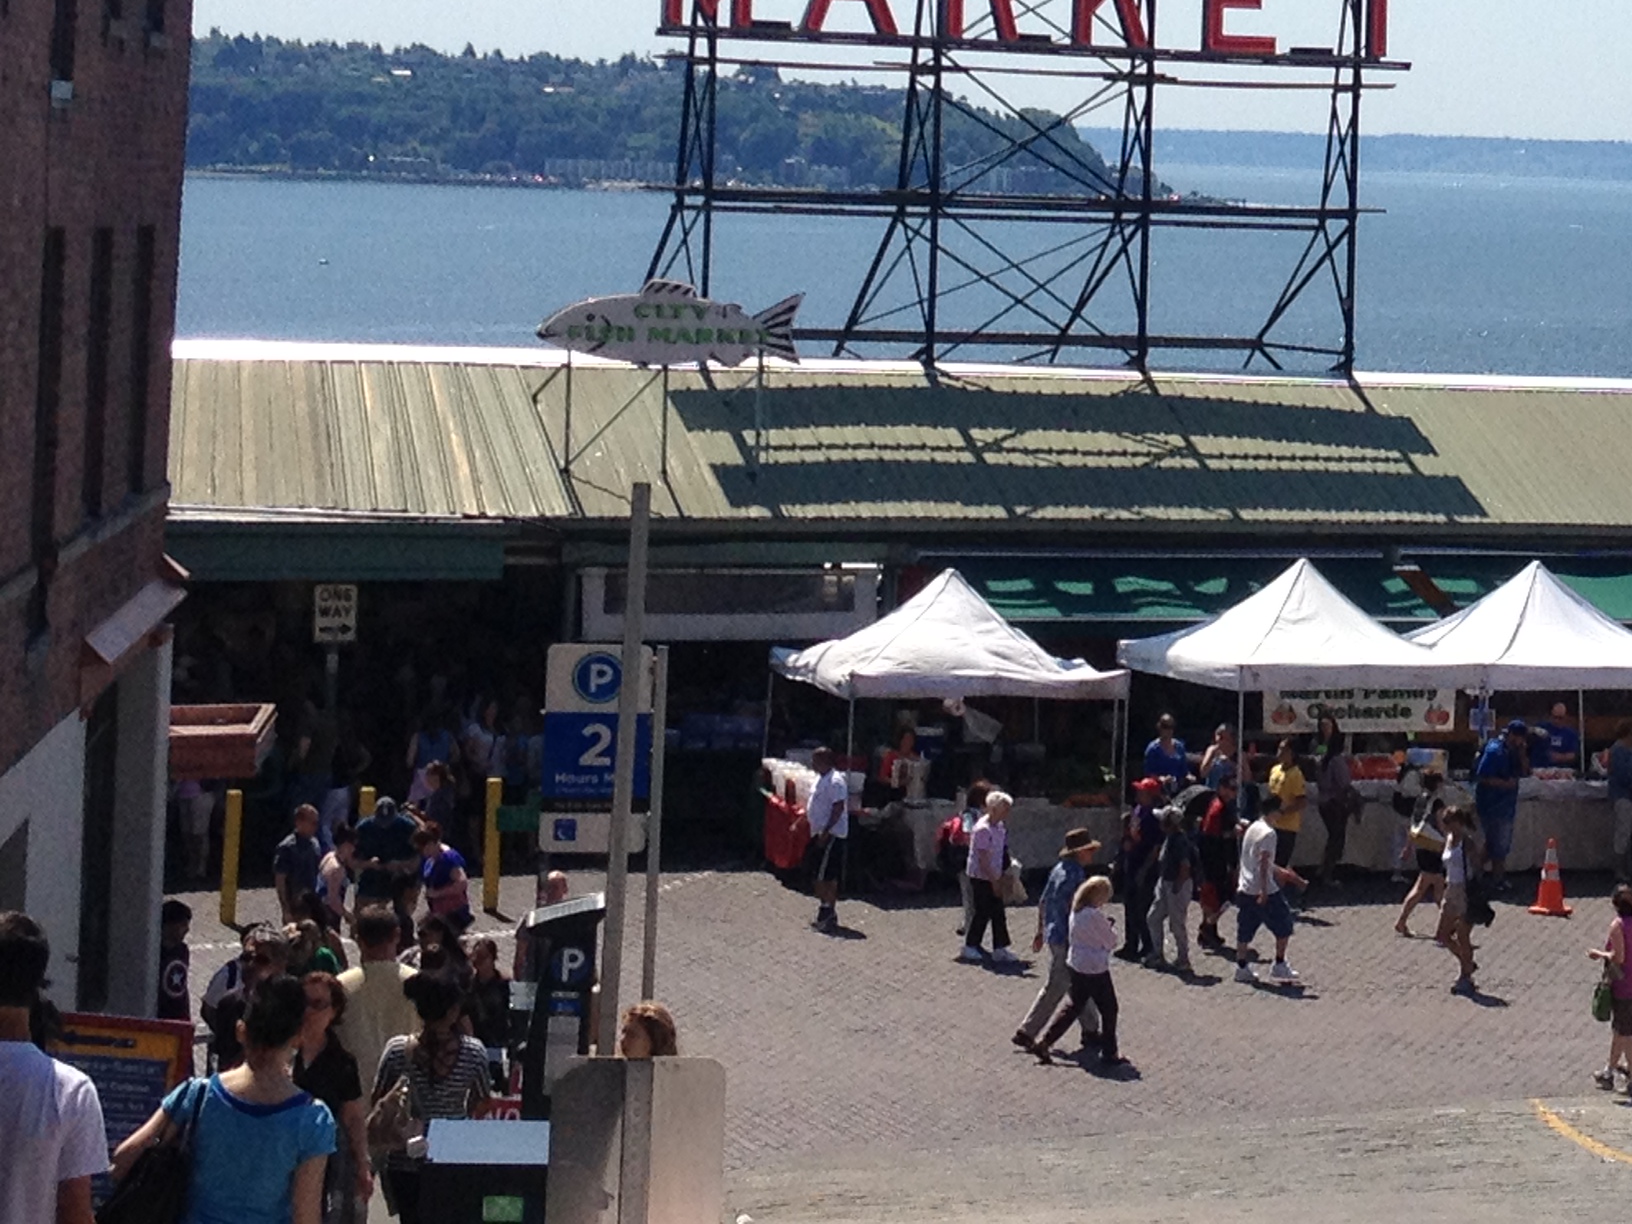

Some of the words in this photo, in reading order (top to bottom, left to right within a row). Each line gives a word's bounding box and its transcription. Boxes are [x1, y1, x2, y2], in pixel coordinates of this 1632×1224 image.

[647, 327, 771, 345] MARKET
[319, 586, 354, 603] ONE
[318, 605, 353, 618] WAY
[589, 663, 614, 694] P
[579, 723, 611, 767] 2
[560, 948, 586, 983] P
